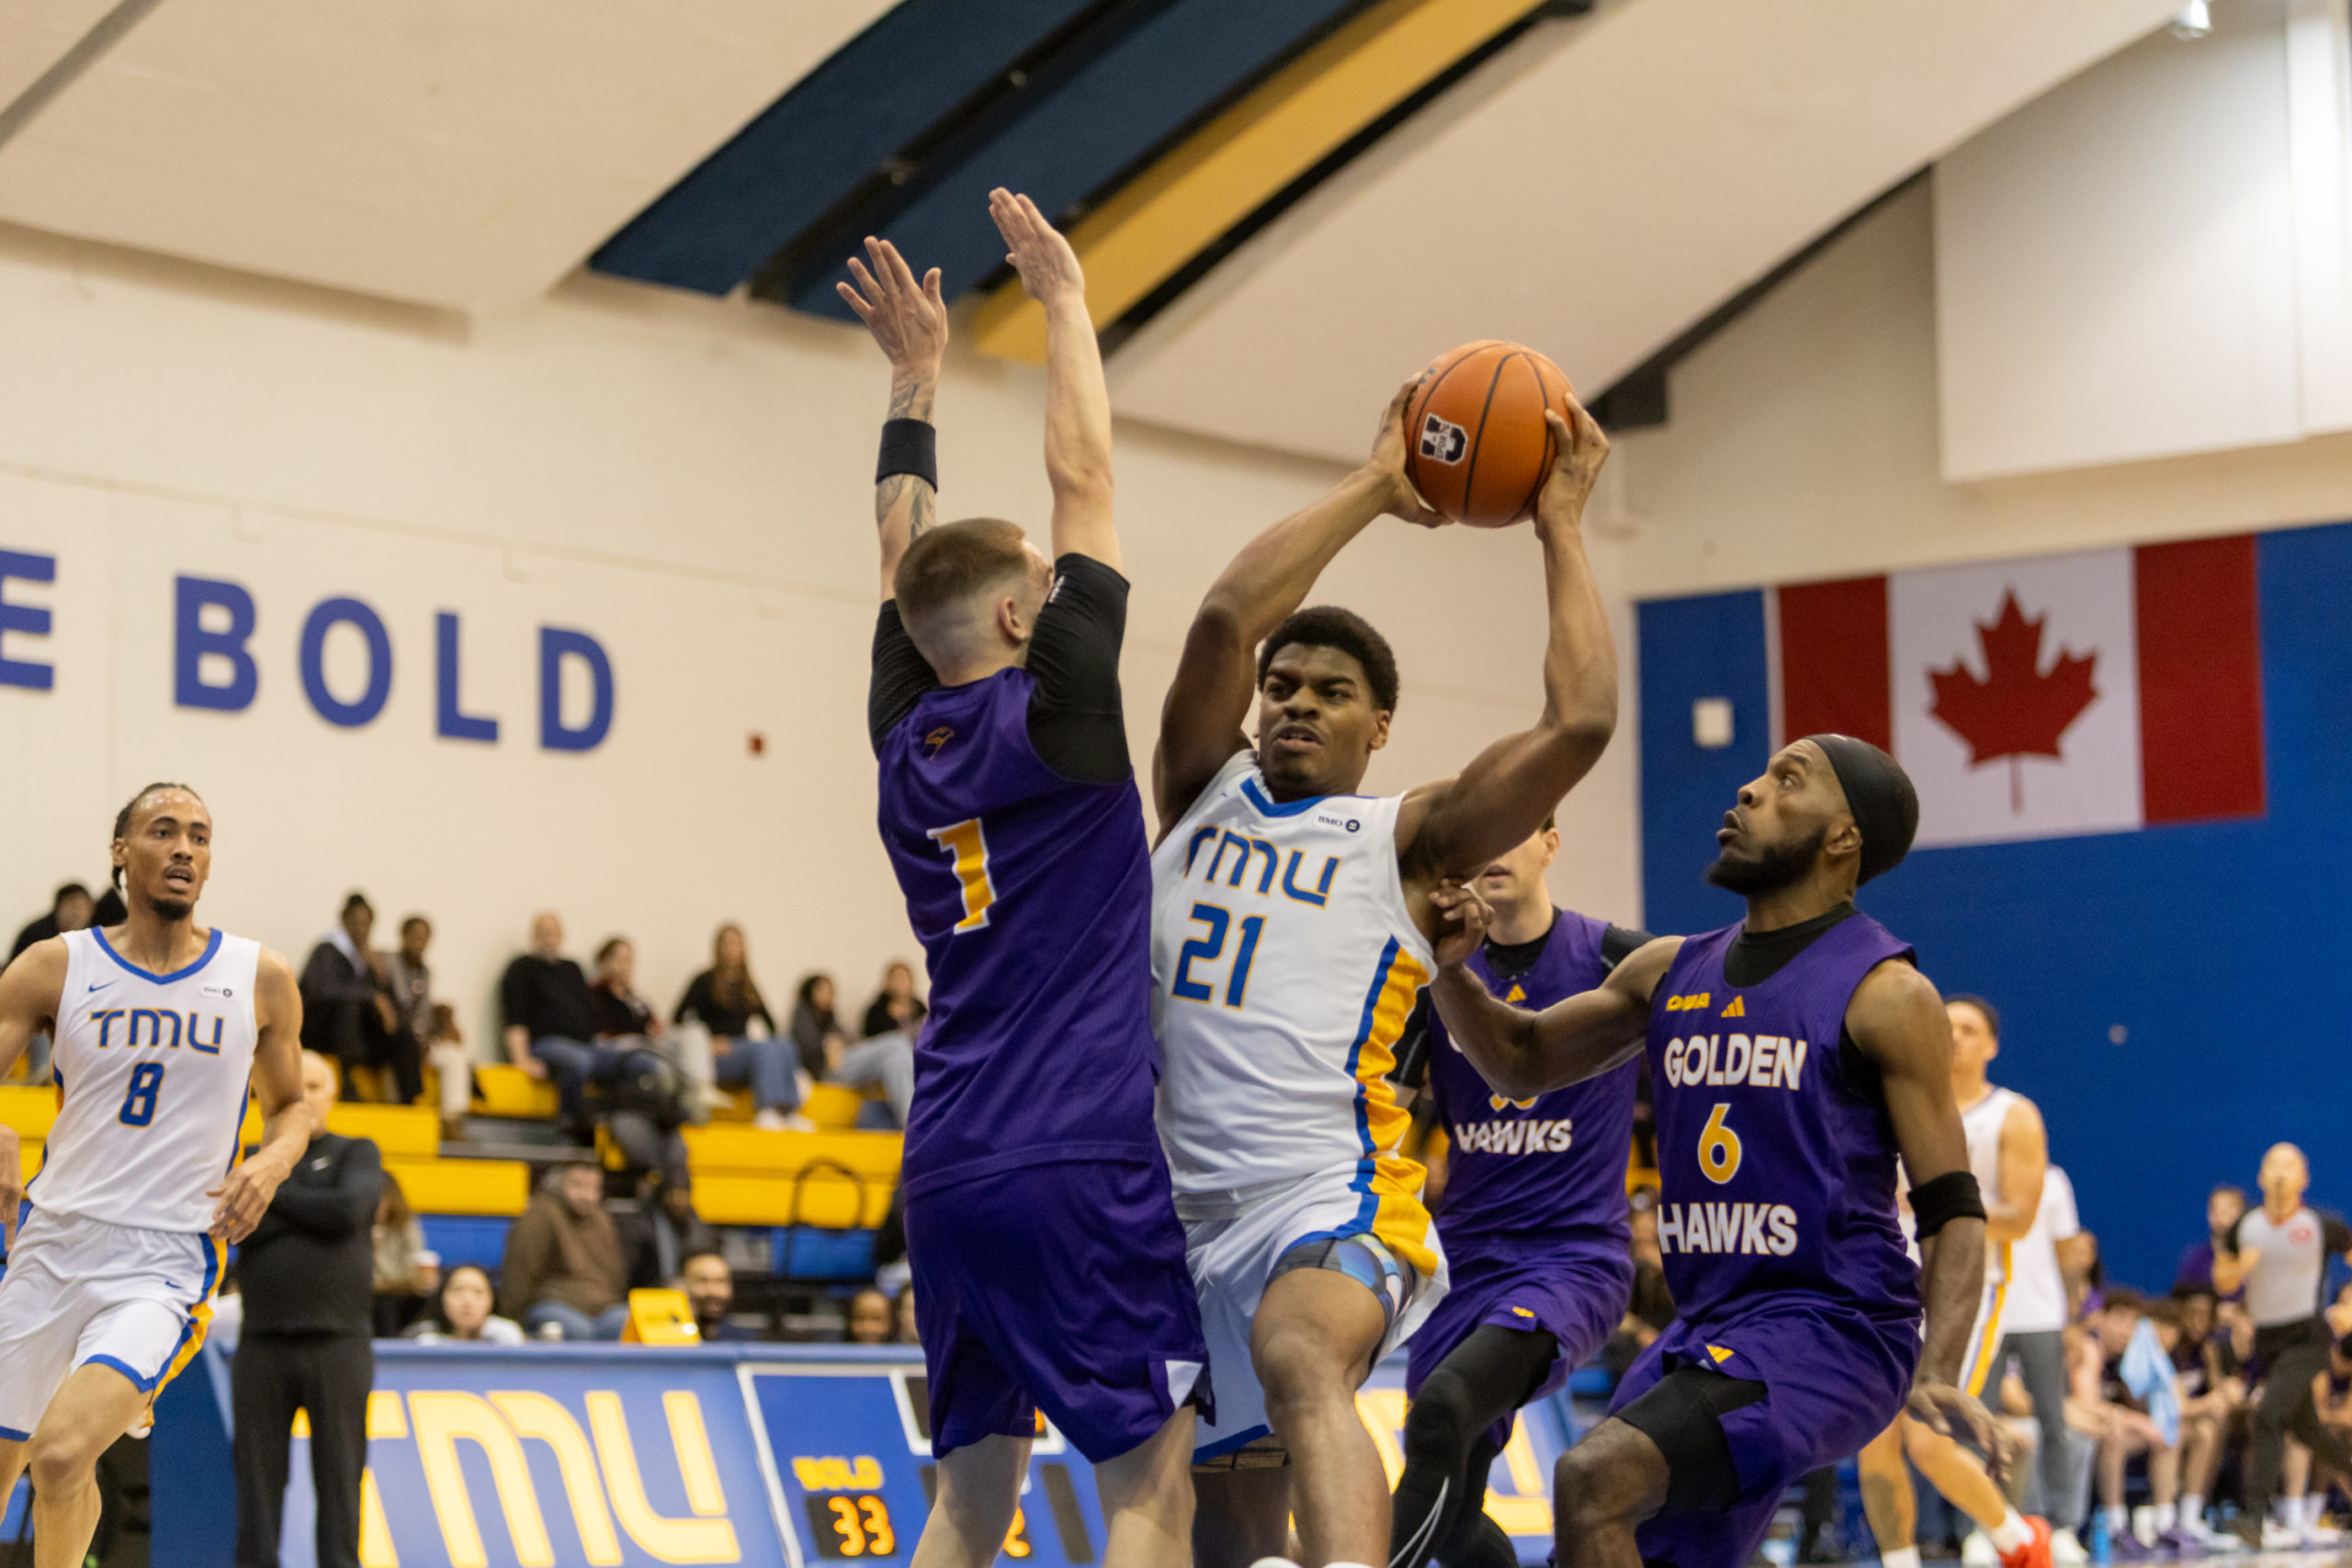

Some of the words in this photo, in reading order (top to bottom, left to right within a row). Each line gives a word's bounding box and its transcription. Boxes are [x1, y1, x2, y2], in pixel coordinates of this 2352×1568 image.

[174, 573, 616, 753] BOLD
[926, 817, 998, 935] 1
[1183, 825, 1342, 910] TMU
[1170, 899, 1268, 1011] 21
[90, 1008, 224, 1055] TMU
[1664, 1033, 1807, 1090] GOLDEN
[118, 1061, 165, 1129] 8
[1697, 1102, 1742, 1185] 6
[1657, 1201, 1799, 1257] HAWKS
[828, 1495, 895, 1556] 33
